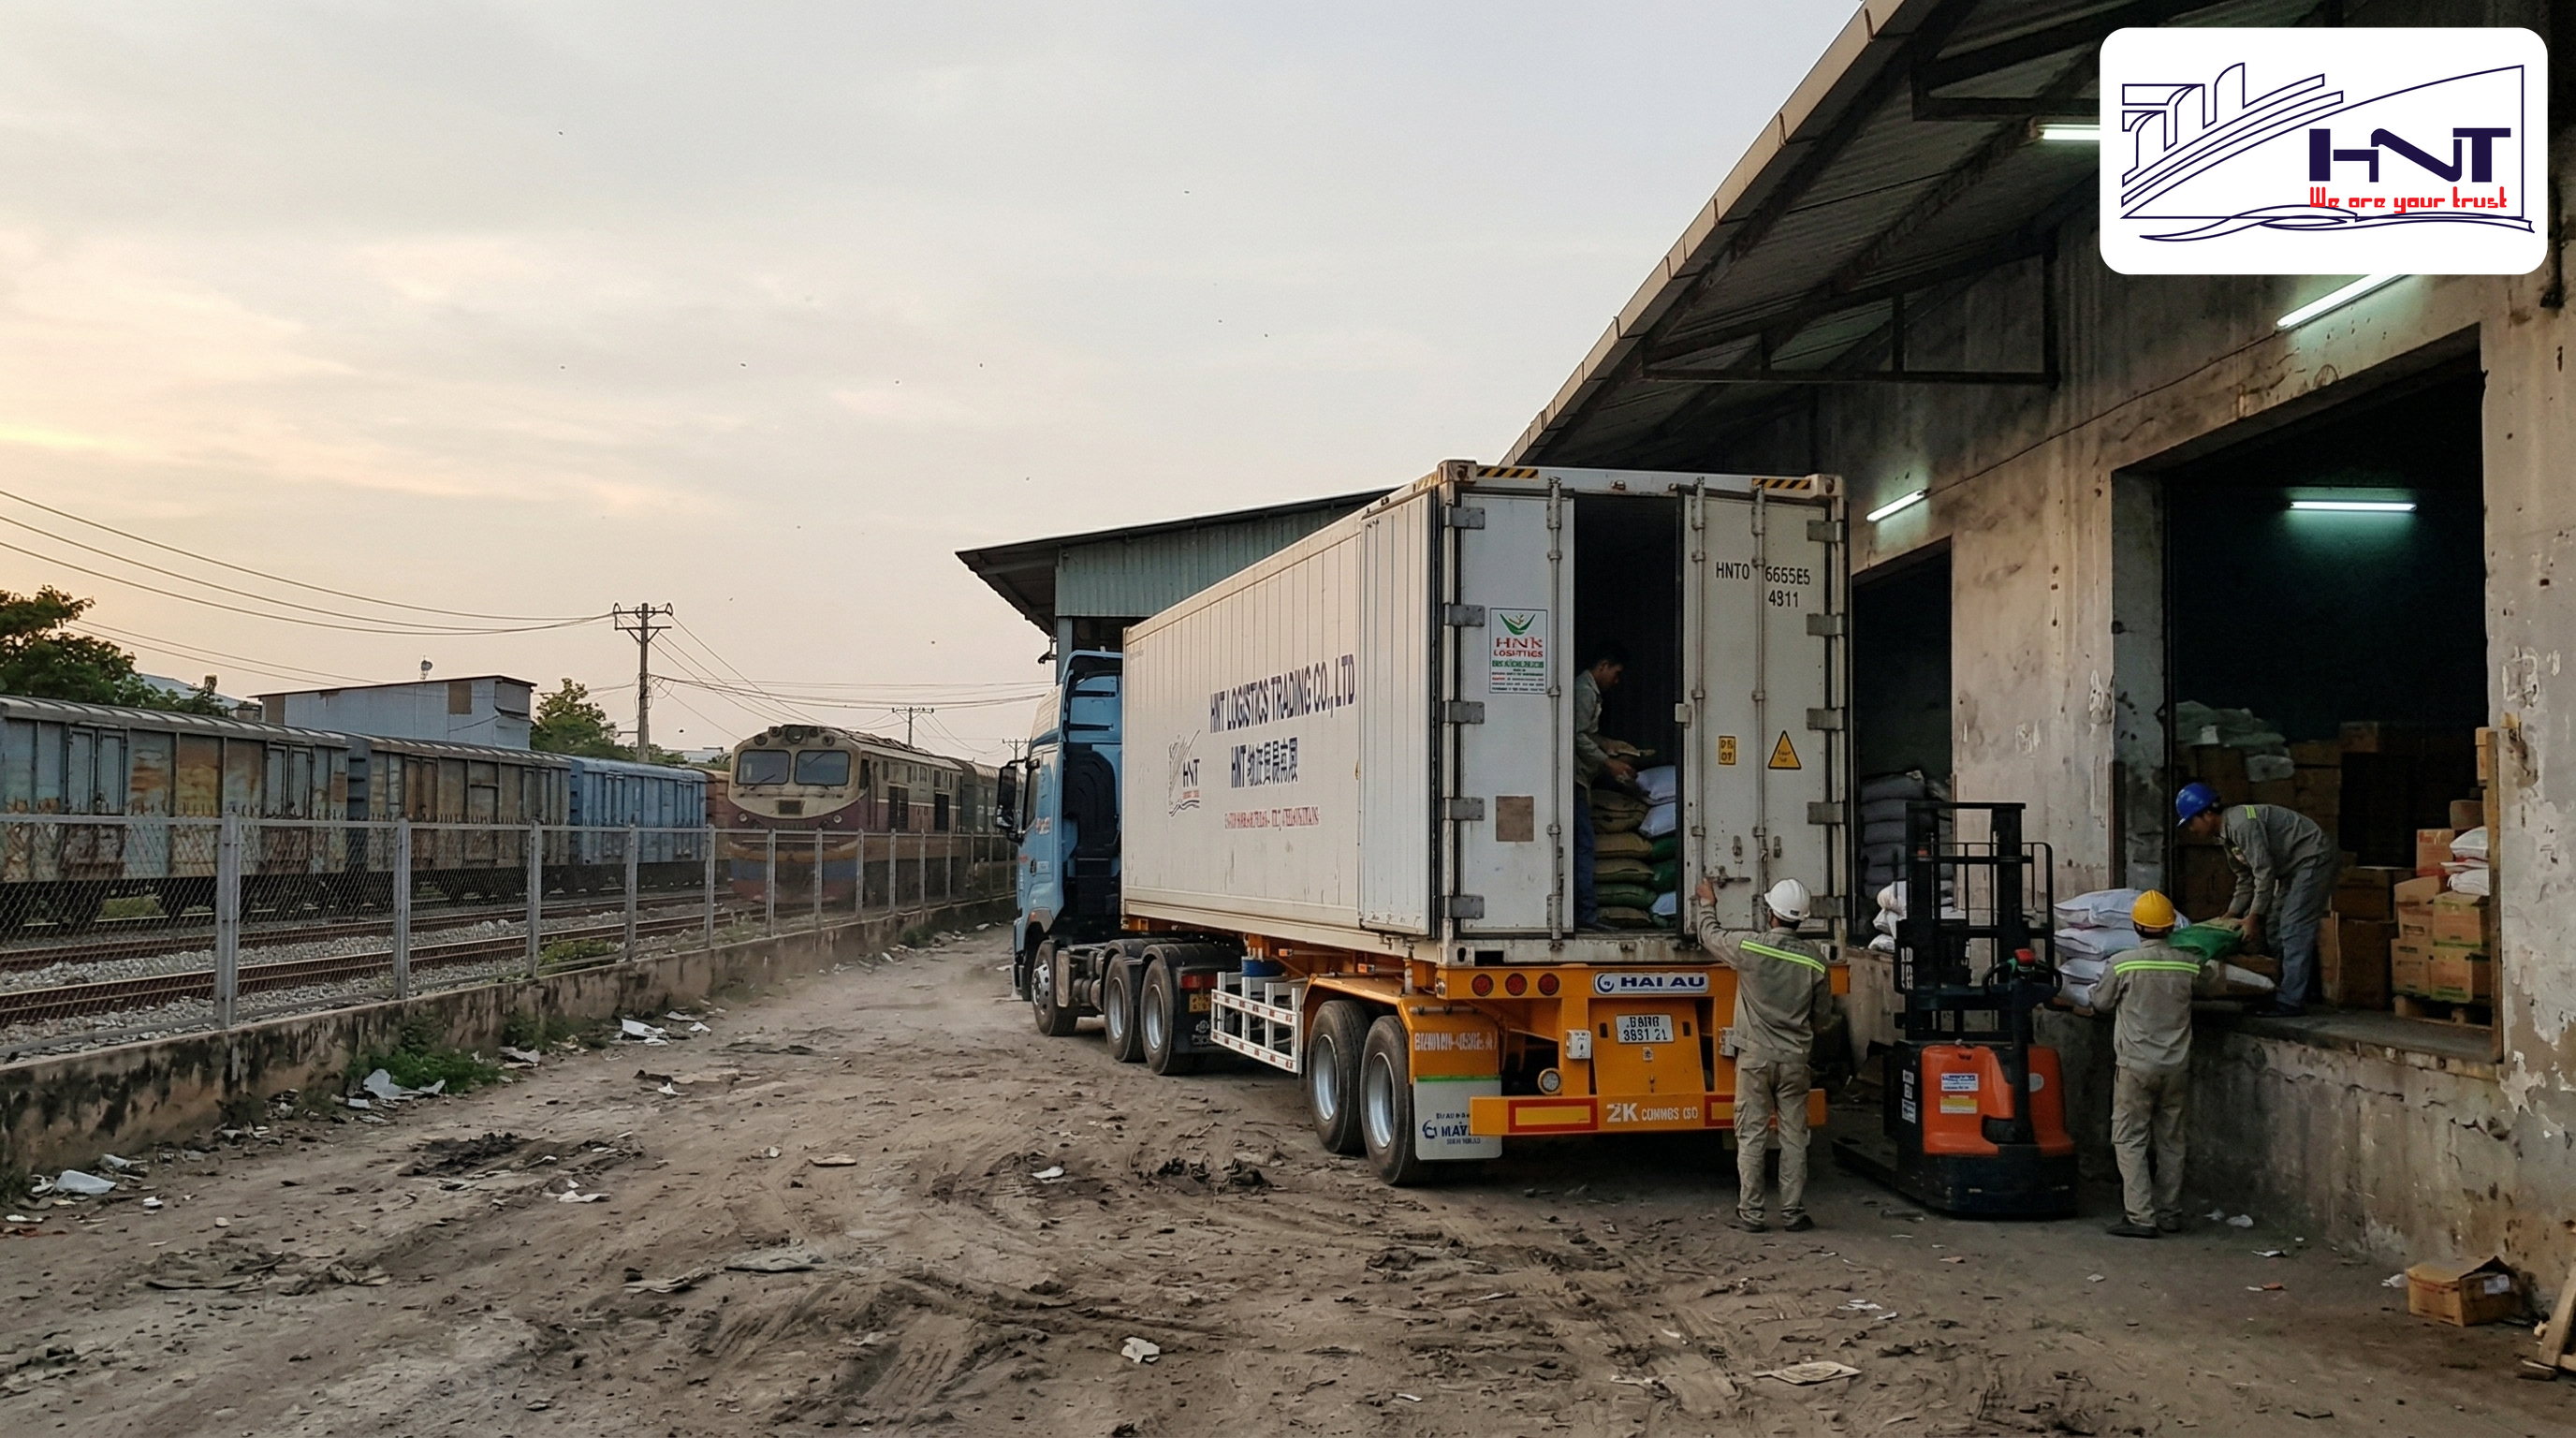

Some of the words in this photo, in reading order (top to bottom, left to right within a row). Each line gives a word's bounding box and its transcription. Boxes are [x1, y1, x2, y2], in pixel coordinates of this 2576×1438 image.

[1210, 691, 1225, 733] HNT
[1227, 678, 1269, 730] LOGISTICS
[1271, 665, 1311, 721] TRADING
[1182, 758, 1200, 787] HNT
[1231, 744, 1246, 788] HNT
[1606, 1102, 1639, 1123] 2K
